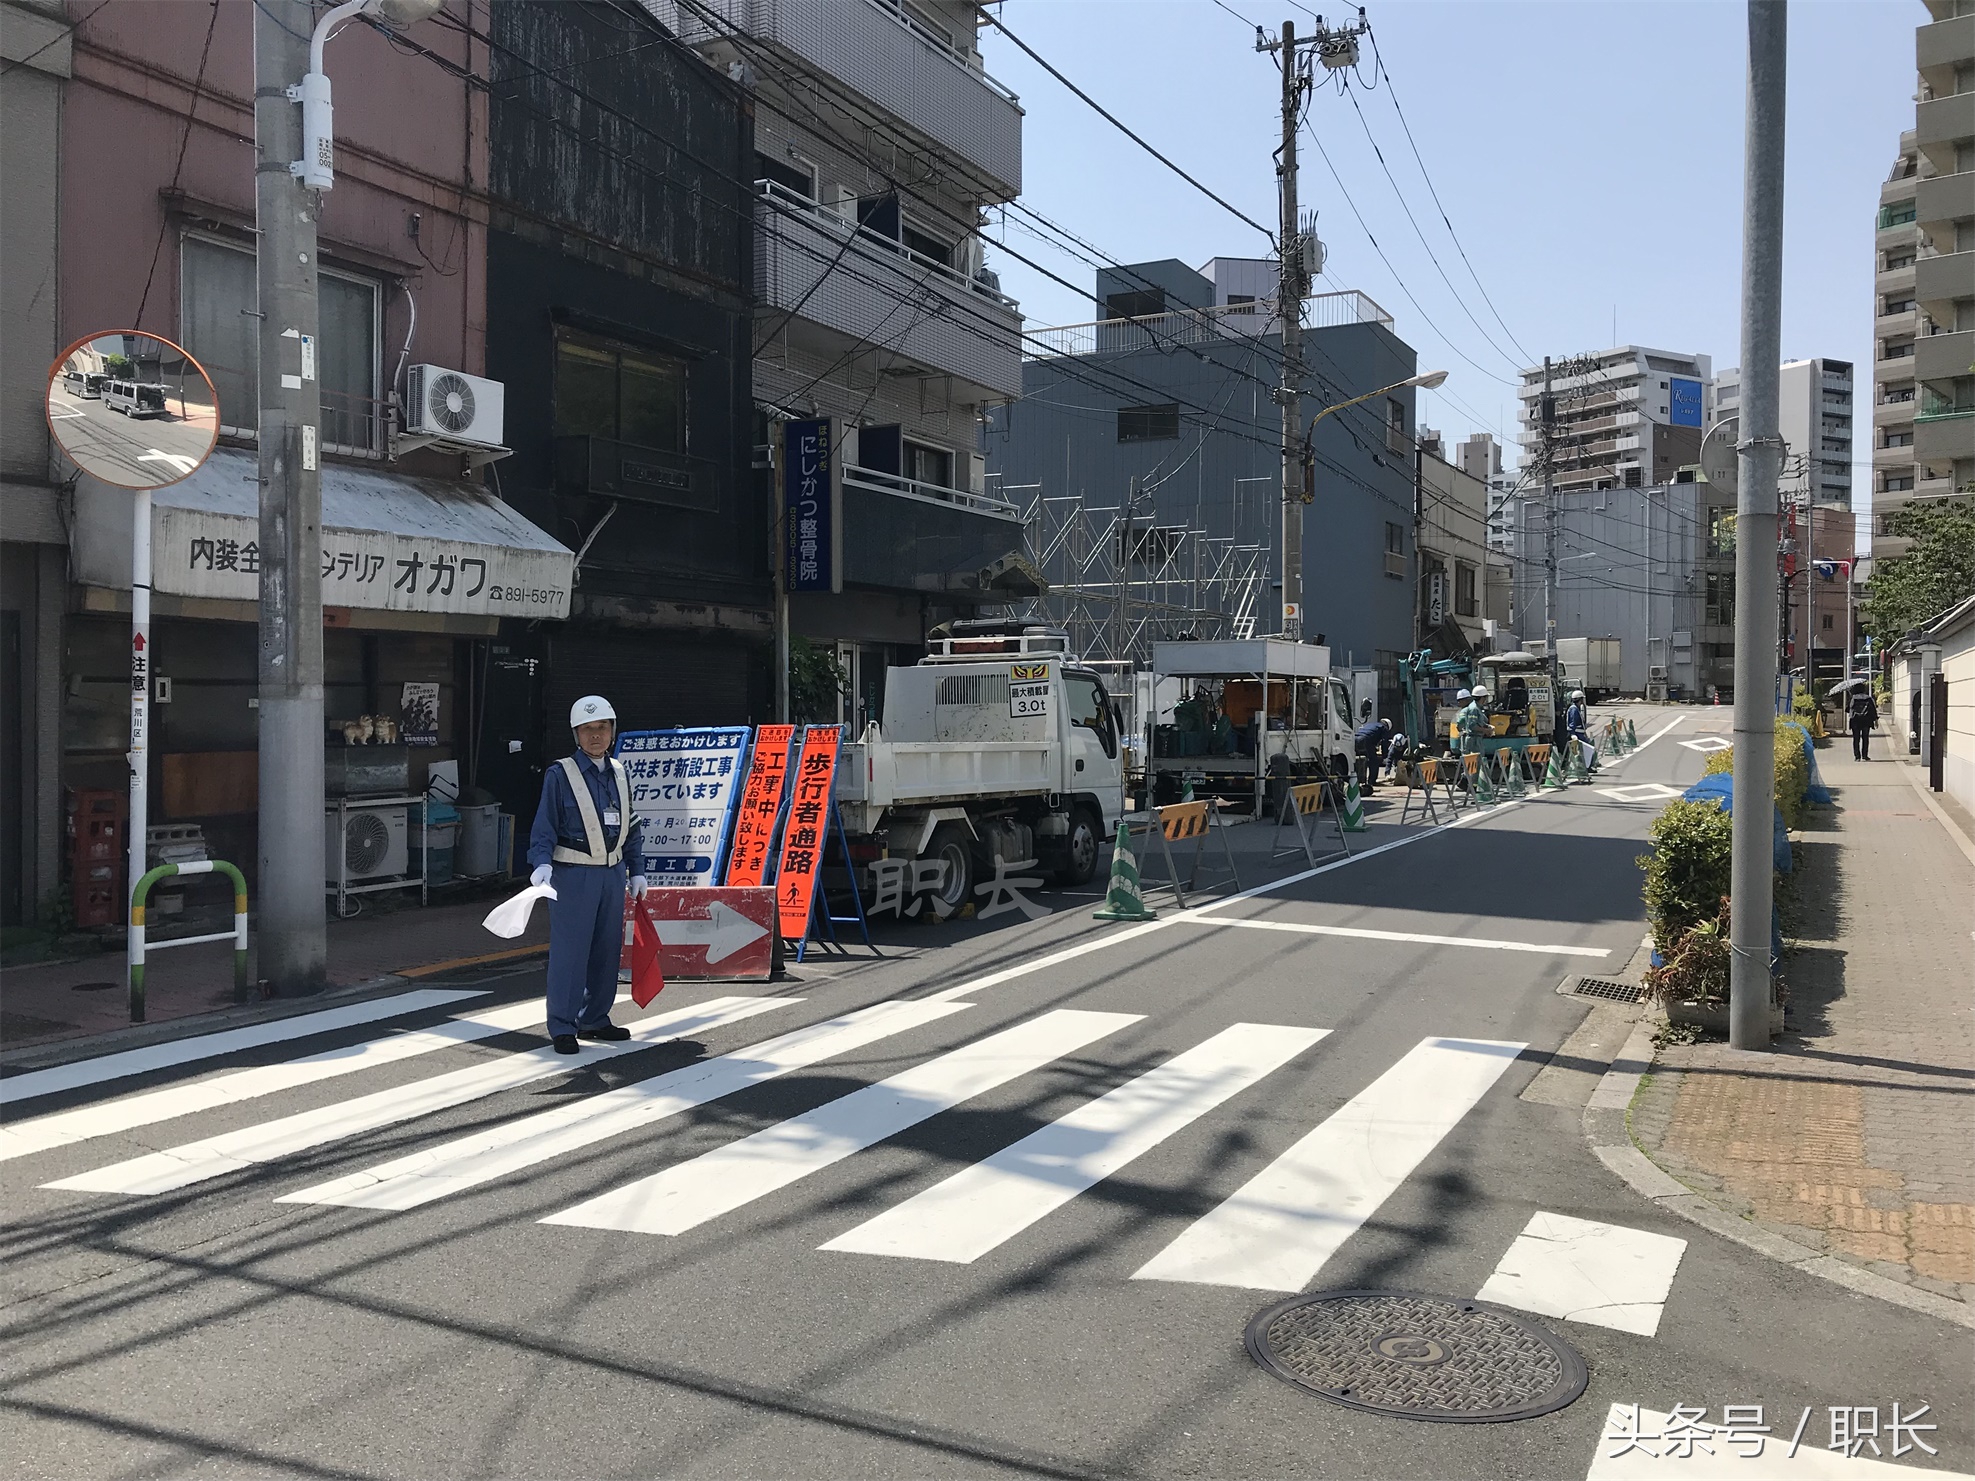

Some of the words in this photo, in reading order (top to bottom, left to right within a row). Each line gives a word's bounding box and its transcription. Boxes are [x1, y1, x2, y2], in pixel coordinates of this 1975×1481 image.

[818, 425, 828, 472] ほねつぎ
[800, 436, 818, 581] にしかつ整骨院
[394, 551, 487, 598] オガワ
[505, 586, 565, 605] 891-5977
[1431, 598, 1441, 621] たこ
[132, 656, 147, 691] 注意
[133, 707, 143, 738] 荒川区
[1018, 699, 1046, 713] 3.0t
[622, 734, 741, 750] ご迷惑をおかけします
[633, 782, 723, 801] 行っています
[734, 752, 767, 870] ご協力お願い致します
[750, 752, 785, 871] 工事中につき
[784, 753, 831, 874] 歩行者通路
